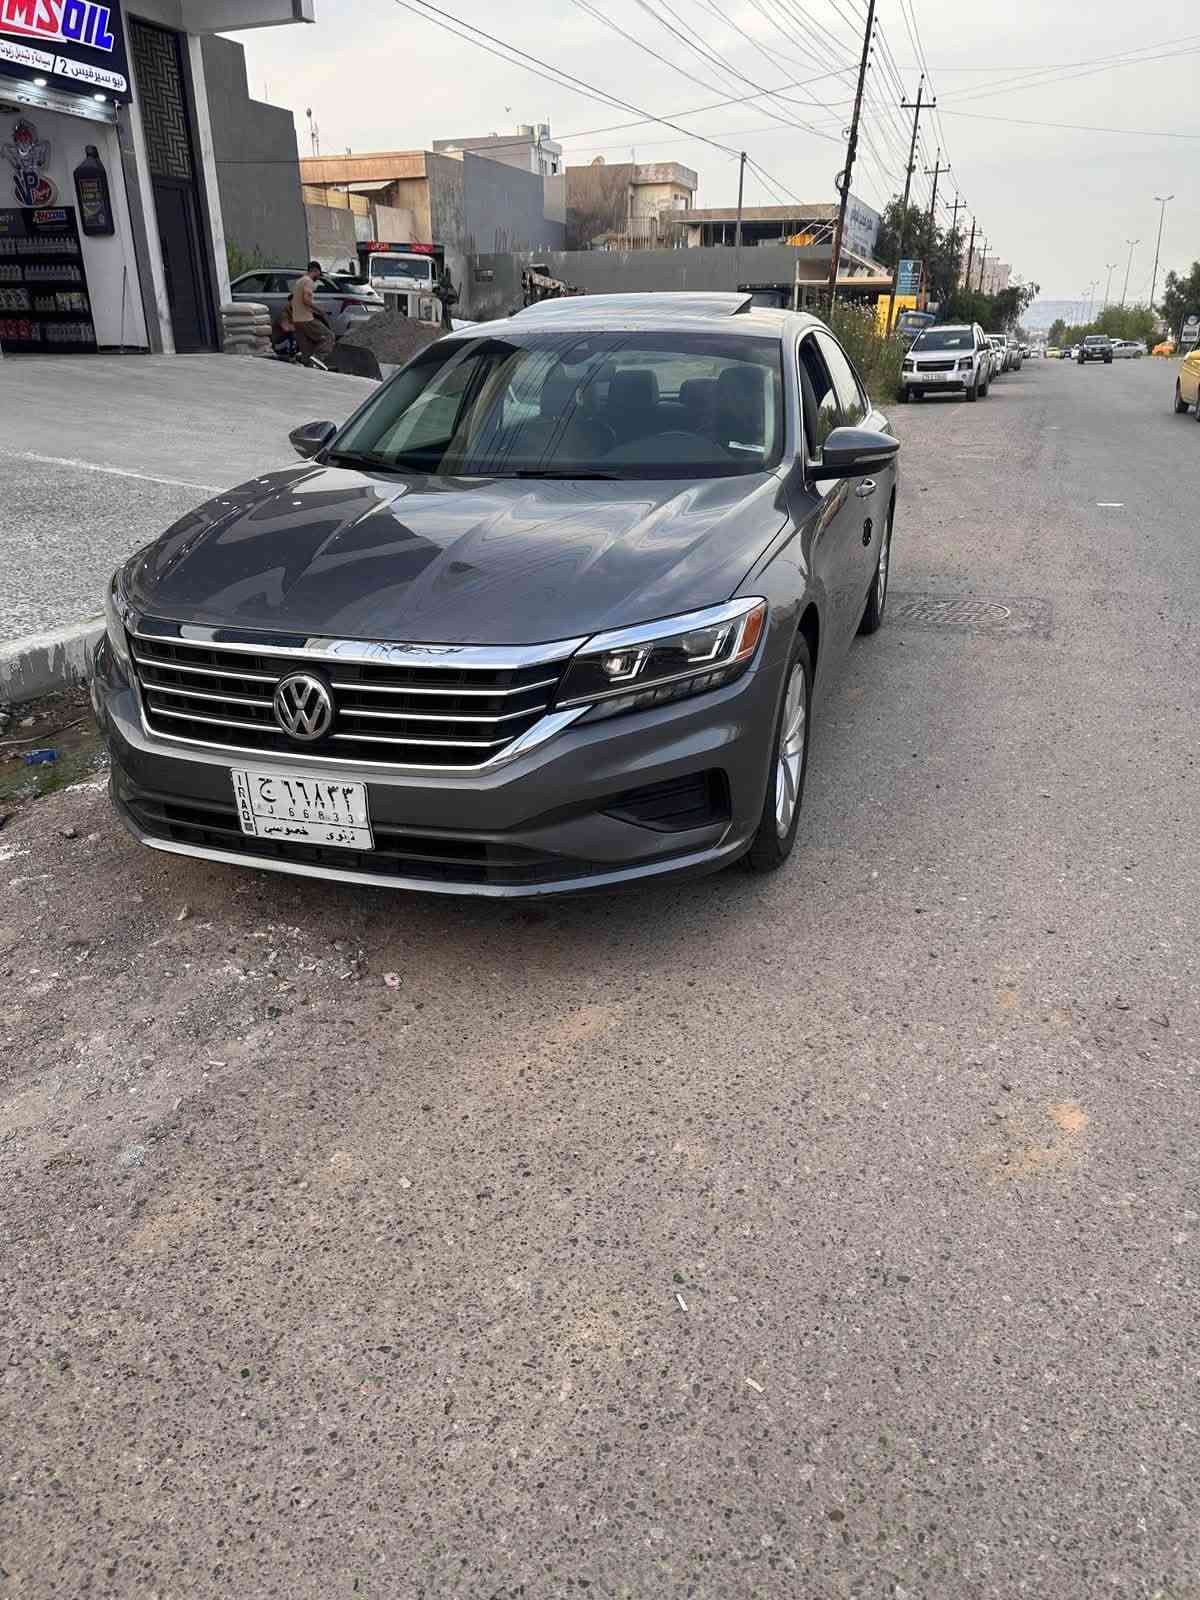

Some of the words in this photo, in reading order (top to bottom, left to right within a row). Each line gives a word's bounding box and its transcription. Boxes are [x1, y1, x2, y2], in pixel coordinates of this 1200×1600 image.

[0, 0, 114, 52] MSOIL
[59, 58, 69, 74] 2
[236, 774, 251, 821] IRAQ
[258, 777, 277, 803] ج
